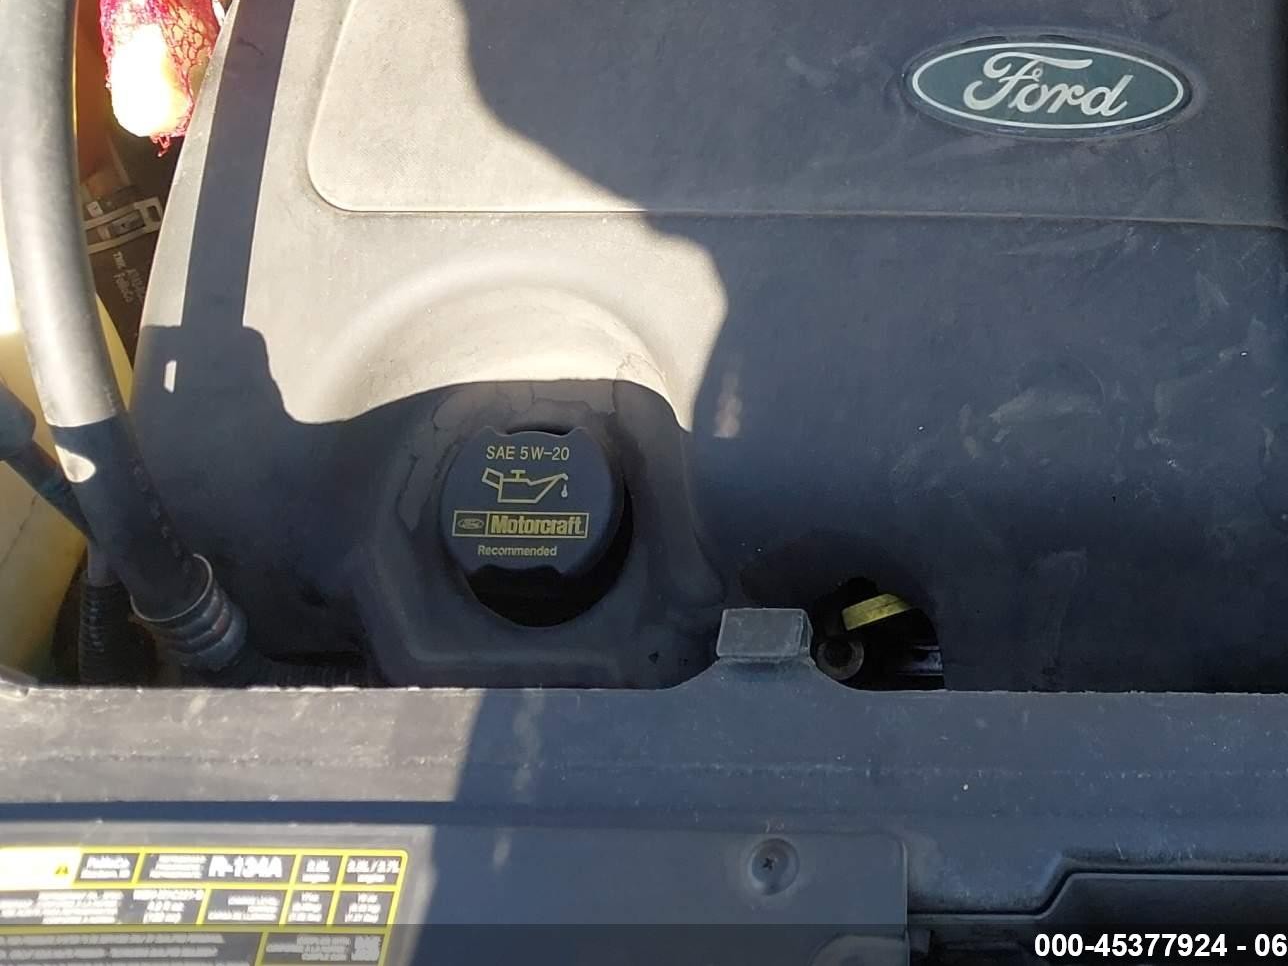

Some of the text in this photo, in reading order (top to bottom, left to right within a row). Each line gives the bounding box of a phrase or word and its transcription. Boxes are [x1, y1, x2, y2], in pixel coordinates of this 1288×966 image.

[963, 51, 1135, 117] Ford
[486, 446, 570, 461] SAE 5W-20
[490, 514, 582, 535] Motorcraft
[477, 545, 558, 557] Recommended
